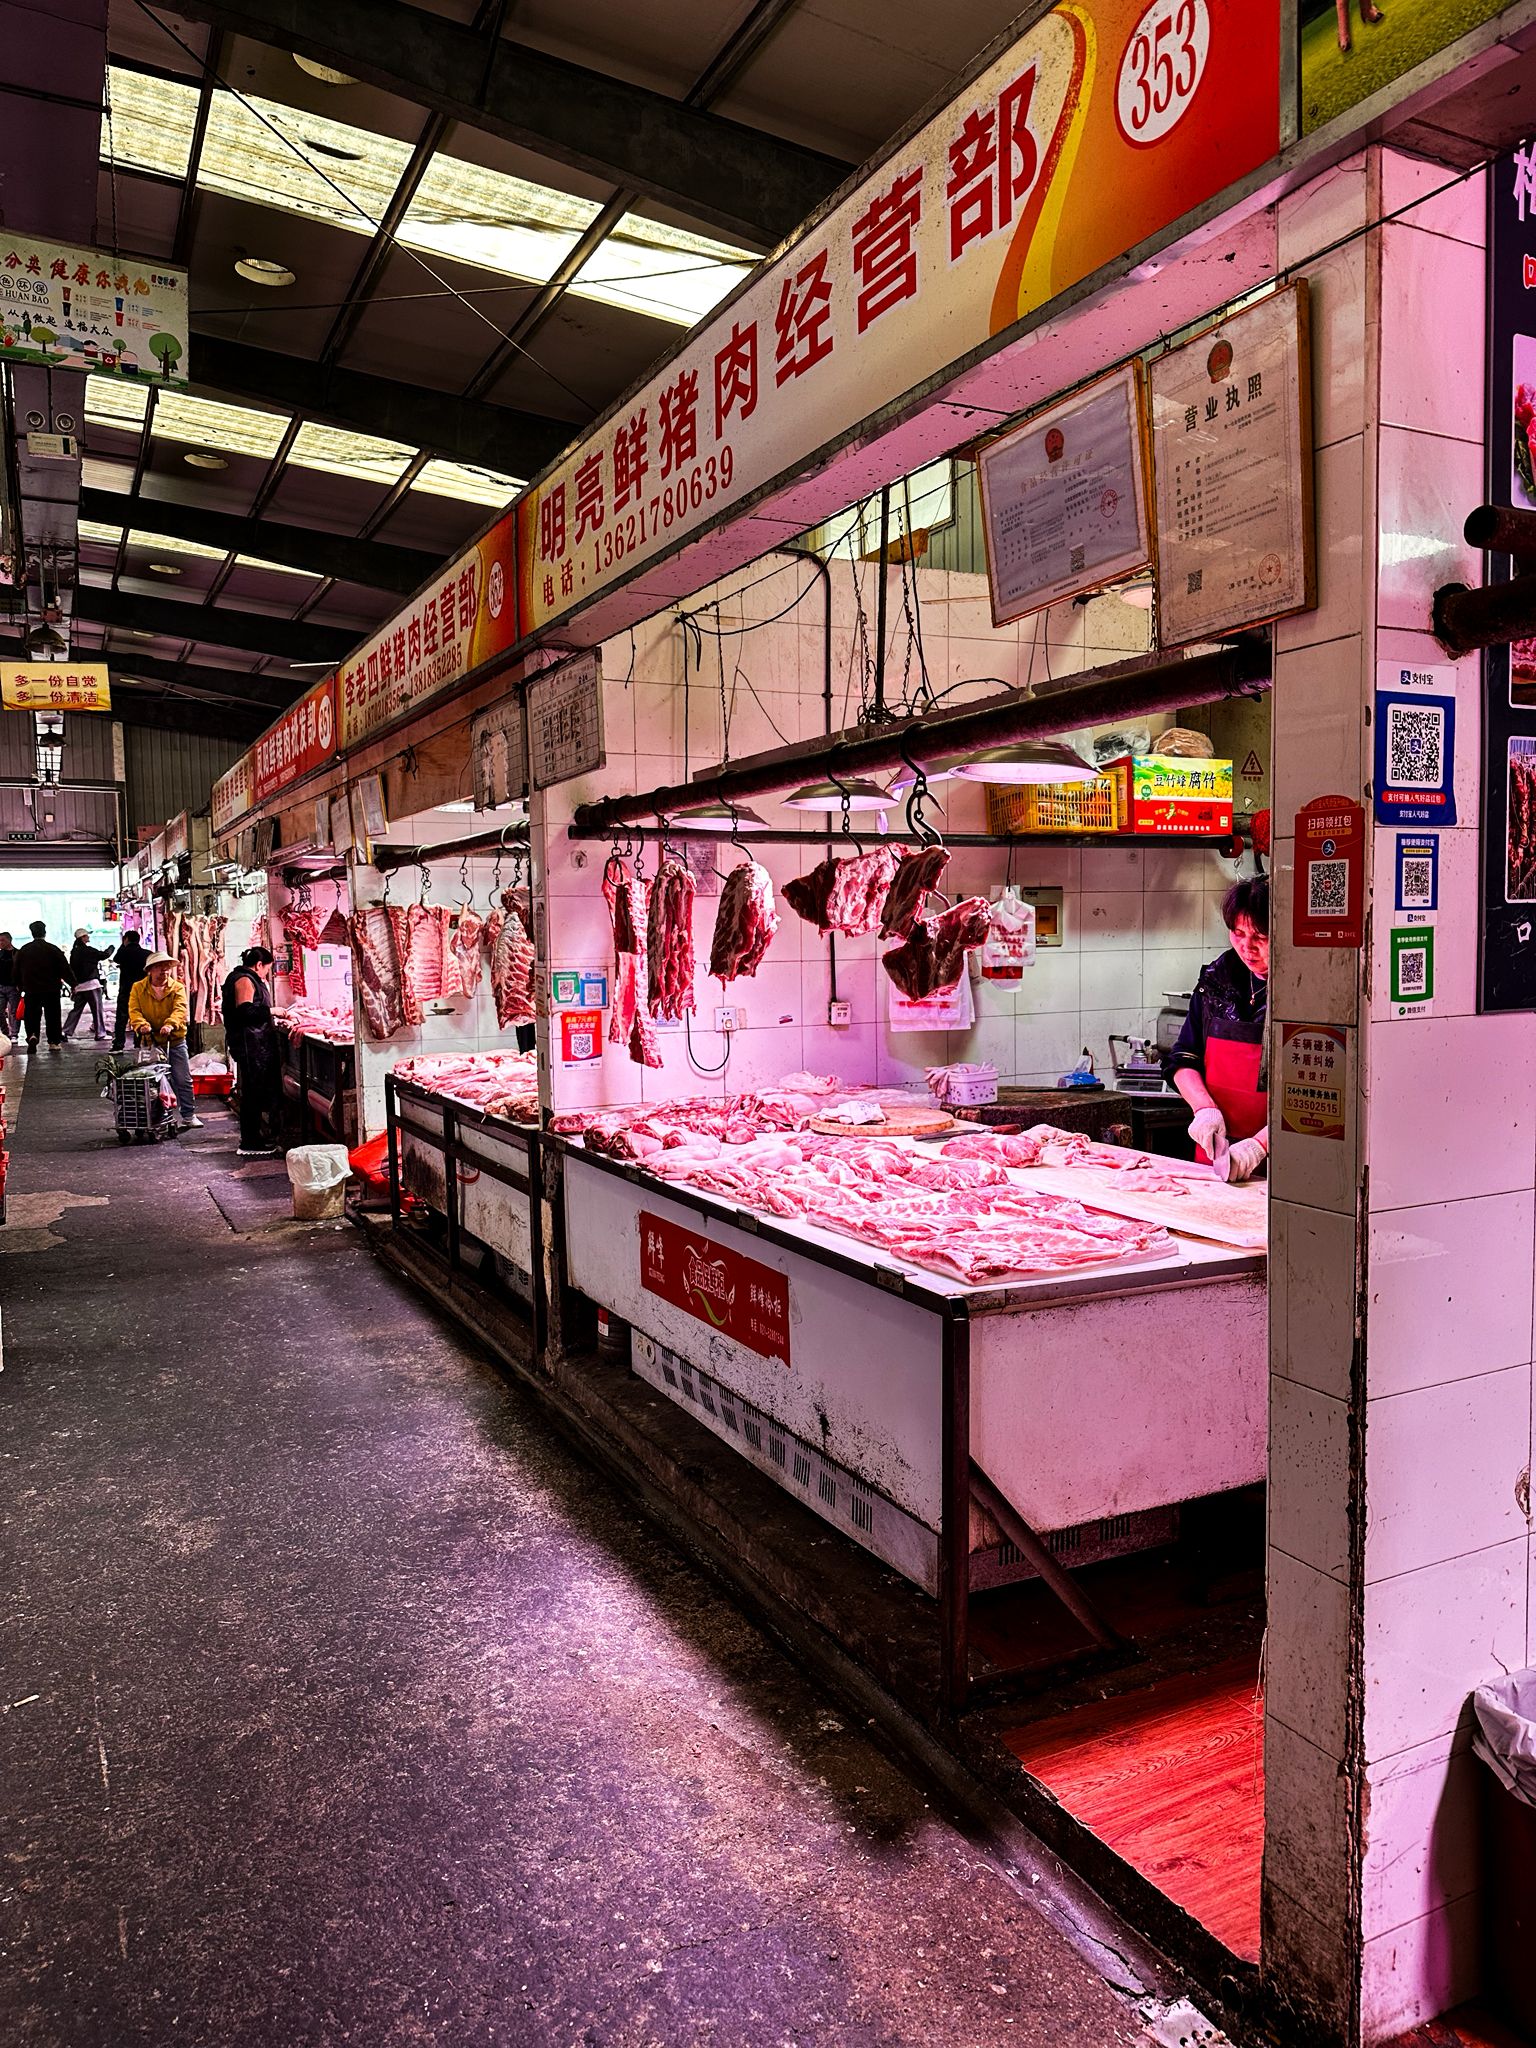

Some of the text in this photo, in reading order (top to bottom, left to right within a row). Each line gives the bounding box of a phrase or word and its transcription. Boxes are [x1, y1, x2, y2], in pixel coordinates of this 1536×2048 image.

[1131, 0, 1196, 130] 353
[5, 290, 31, 303] HUAN
[31, 294, 50, 306] BAO
[539, 60, 1041, 563] 明亮鲜猪肉经营部
[1184, 372, 1262, 432] 营业执照
[345, 564, 477, 715] 李老四鲜猪肉经营部
[410, 642, 462, 697] 13818352285
[15, 675, 97, 687] 多一份自觉
[1412, 673, 1434, 685] 支付宝
[16, 691, 98, 703] 多一份清洁
[319, 703, 331, 740] 351
[1307, 815, 1352, 830] 扫码领红包
[1407, 1006, 1426, 1014] 微信支付
[1292, 1038, 1335, 1053] 车辆碰擦
[1292, 1053, 1334, 1069] 矛盾纠纷
[1297, 1070, 1328, 1083] 请拨打
[1287, 1086, 1338, 1101] 24小时警务热线
[1293, 1099, 1337, 1114] 33502515
